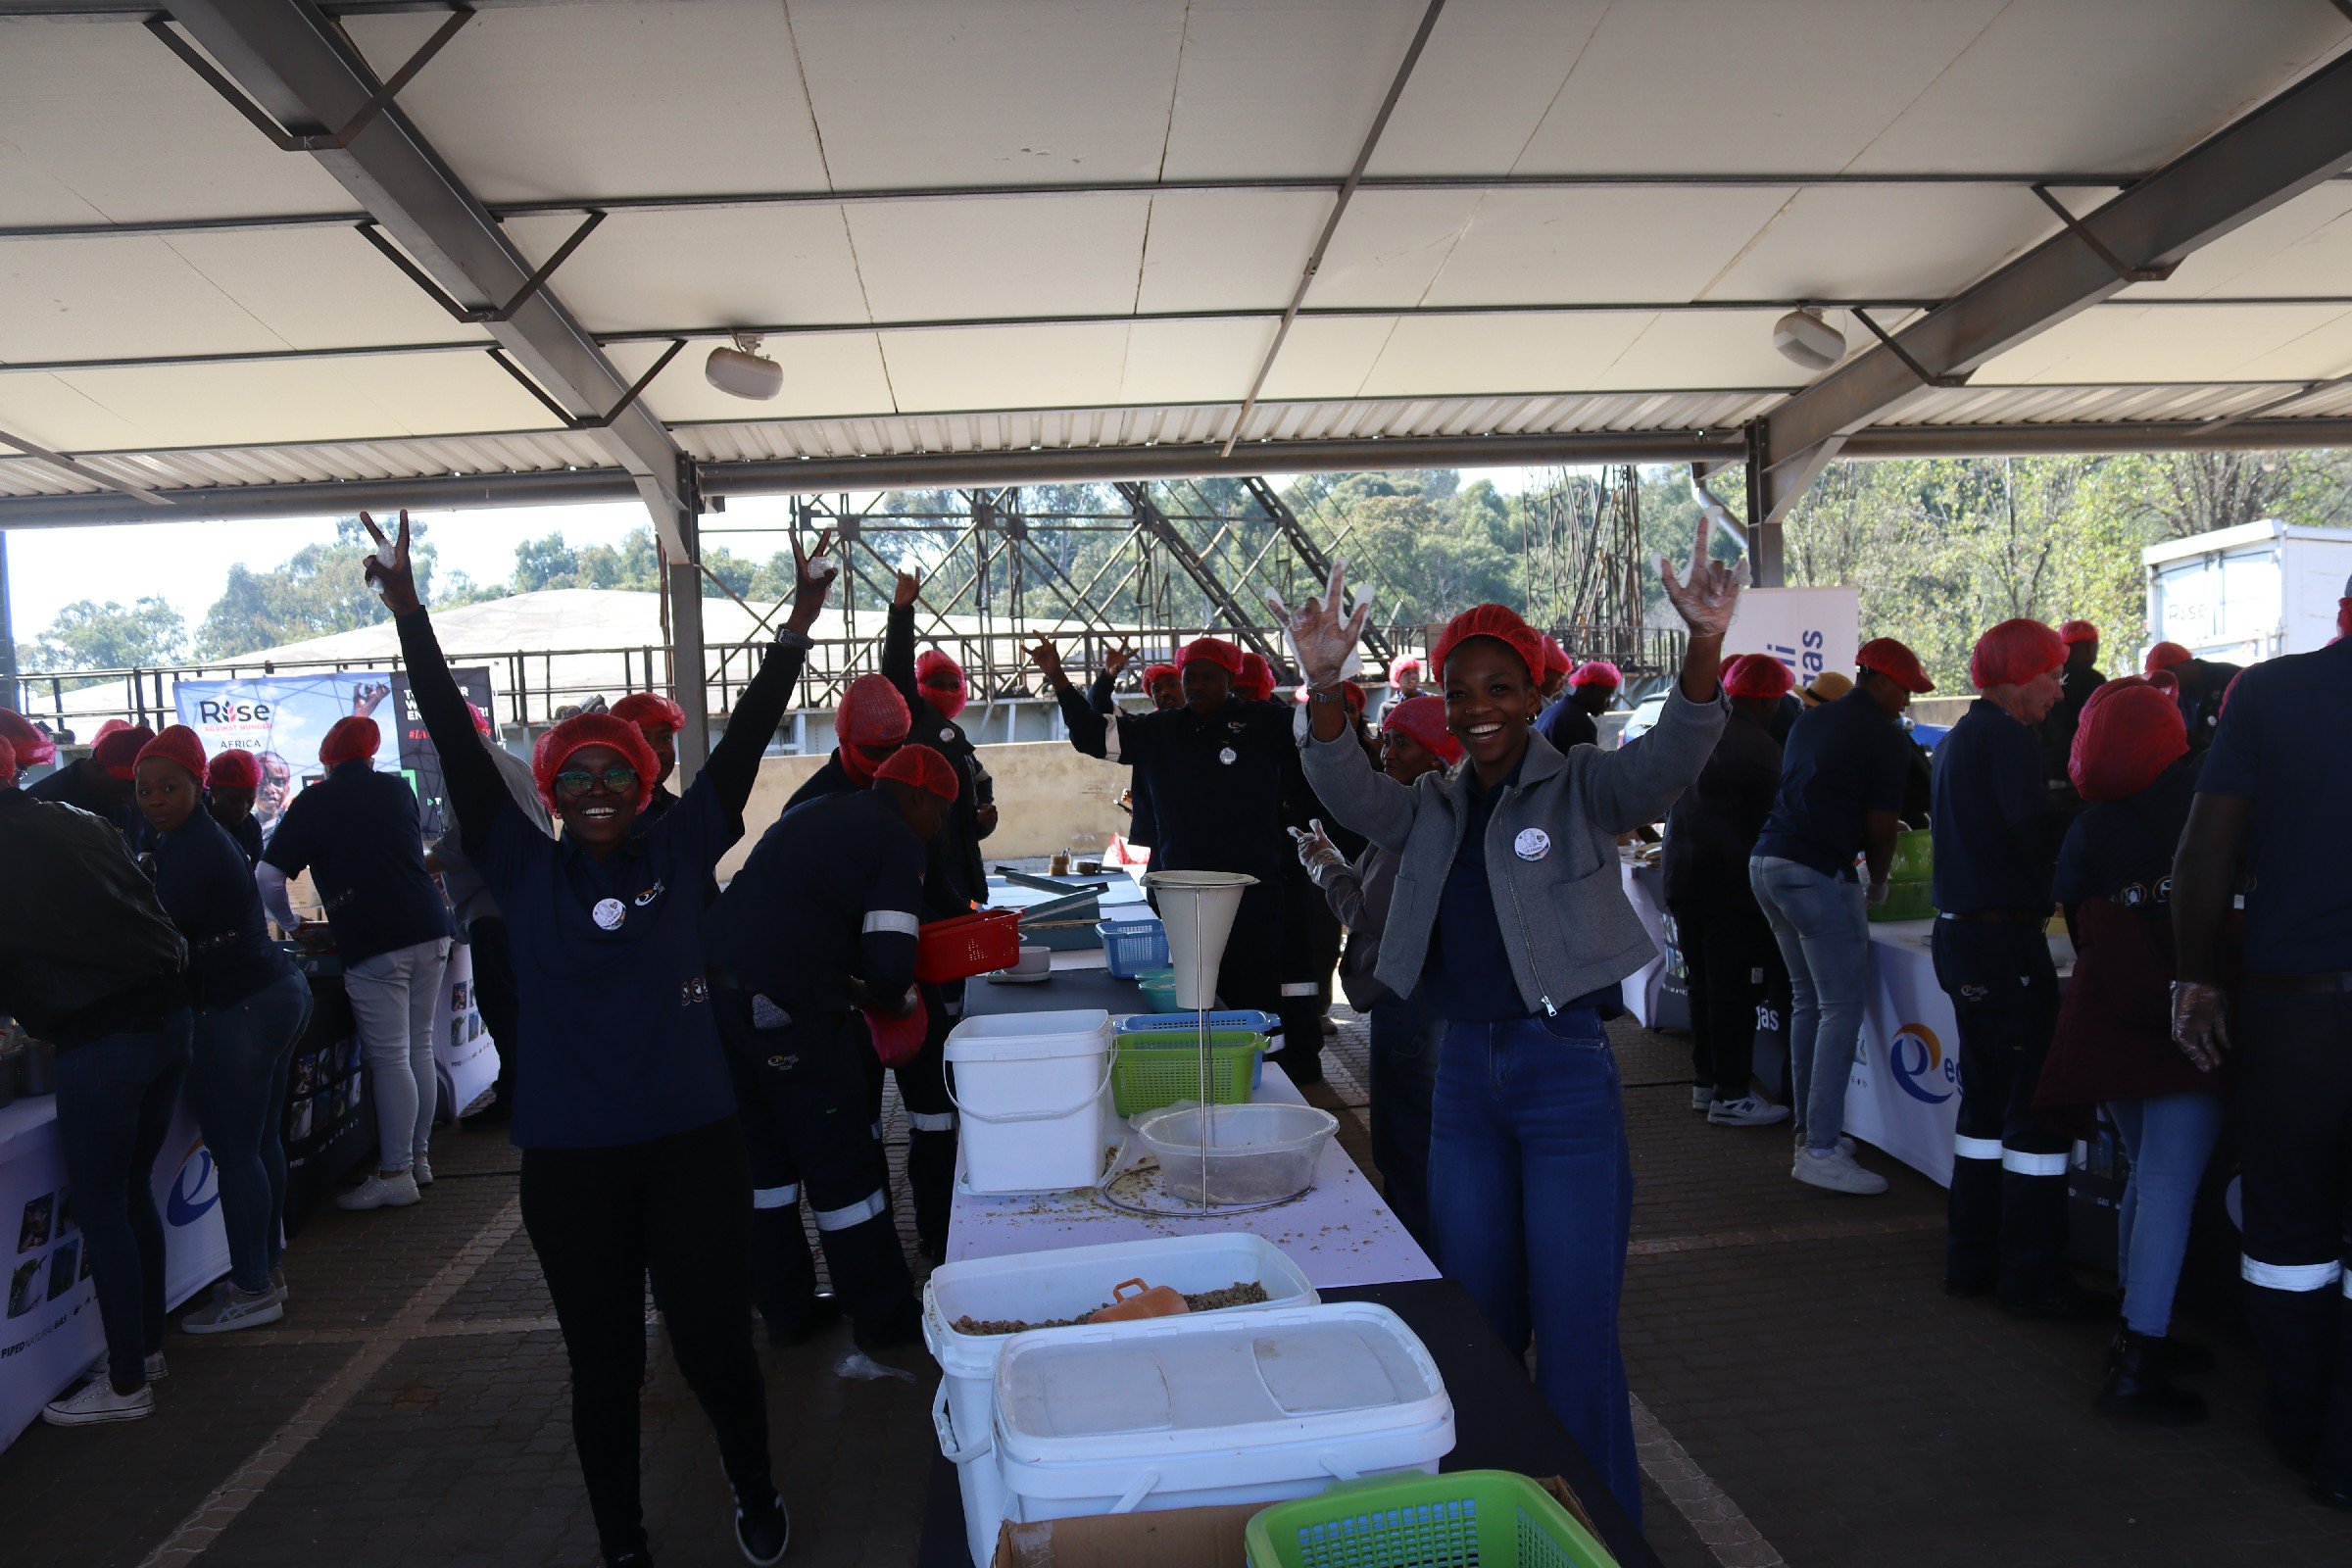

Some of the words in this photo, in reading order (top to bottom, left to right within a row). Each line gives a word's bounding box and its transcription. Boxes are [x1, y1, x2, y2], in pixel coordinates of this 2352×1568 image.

[200, 701, 270, 724] Rise
[220, 739, 262, 749] AFRICA
[1, 1341, 25, 1359] PIPED
[53, 1314, 68, 1330] GAS
